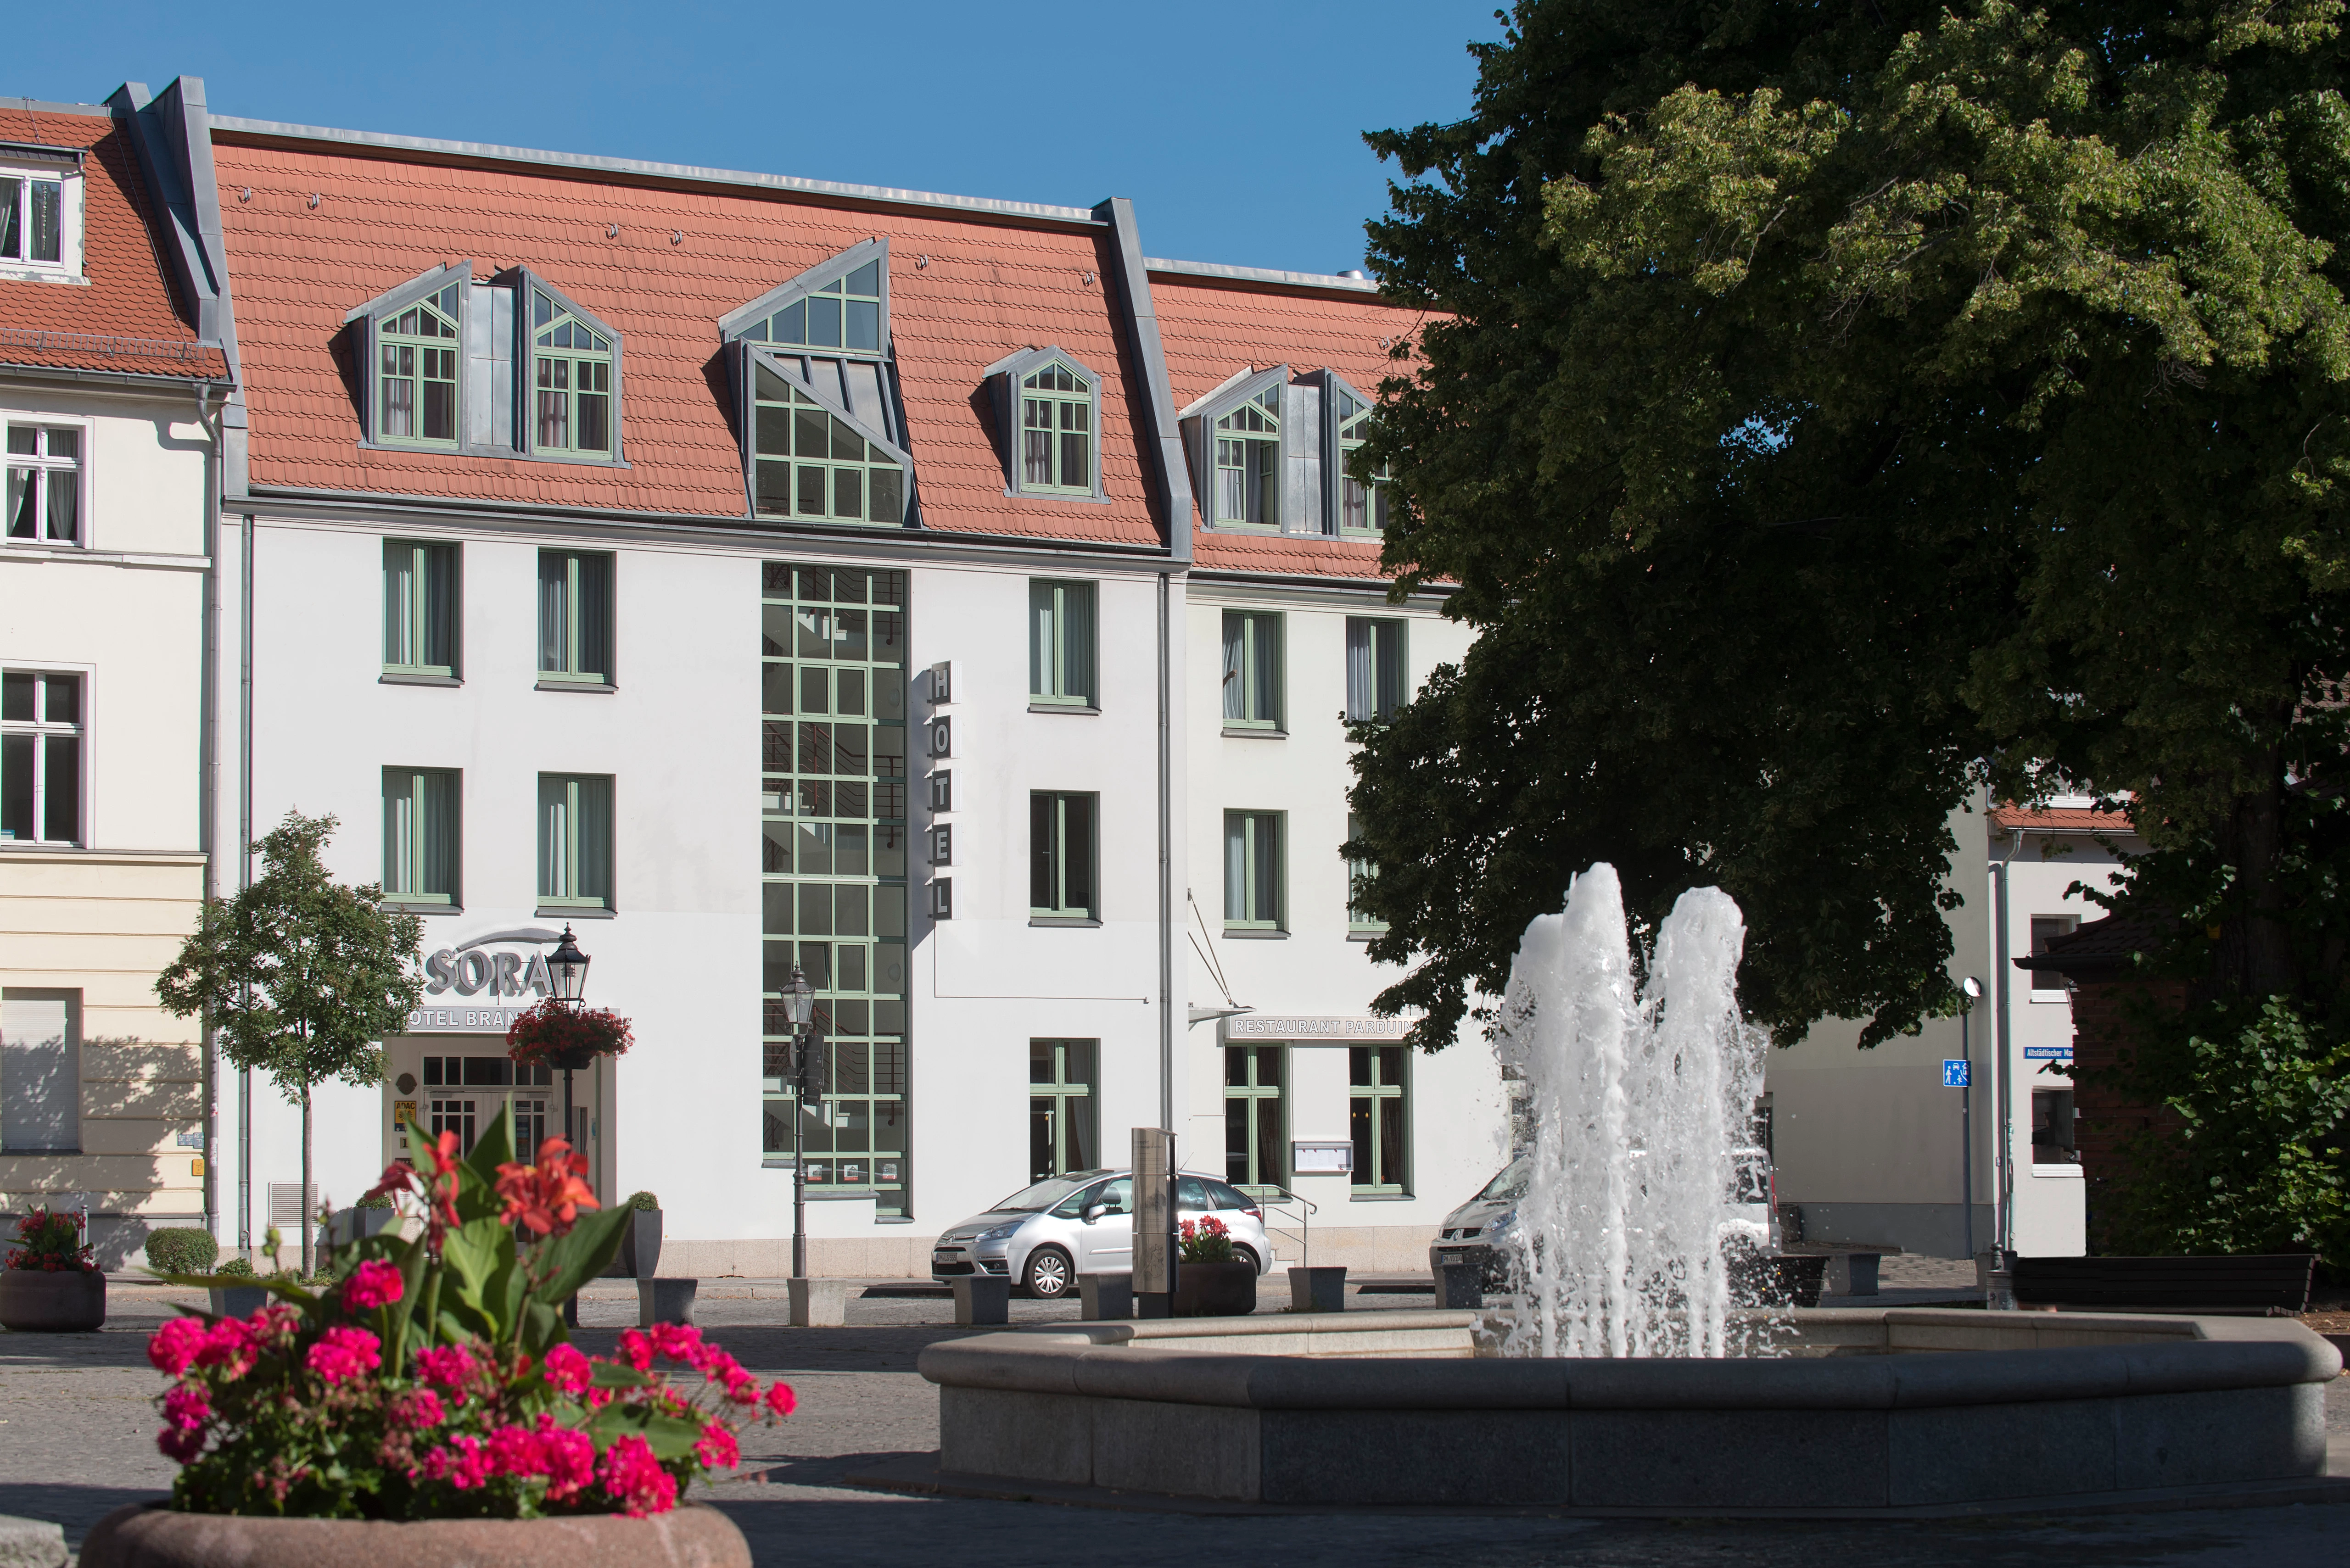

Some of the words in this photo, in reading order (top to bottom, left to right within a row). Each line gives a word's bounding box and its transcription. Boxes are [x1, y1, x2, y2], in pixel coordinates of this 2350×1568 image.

[934, 669, 949, 914] HOTEL
[409, 1010, 459, 1026] OTEL
[1235, 1020, 1341, 1033] RESTAURANT
[1345, 1021, 1414, 1034] PARDUIN
